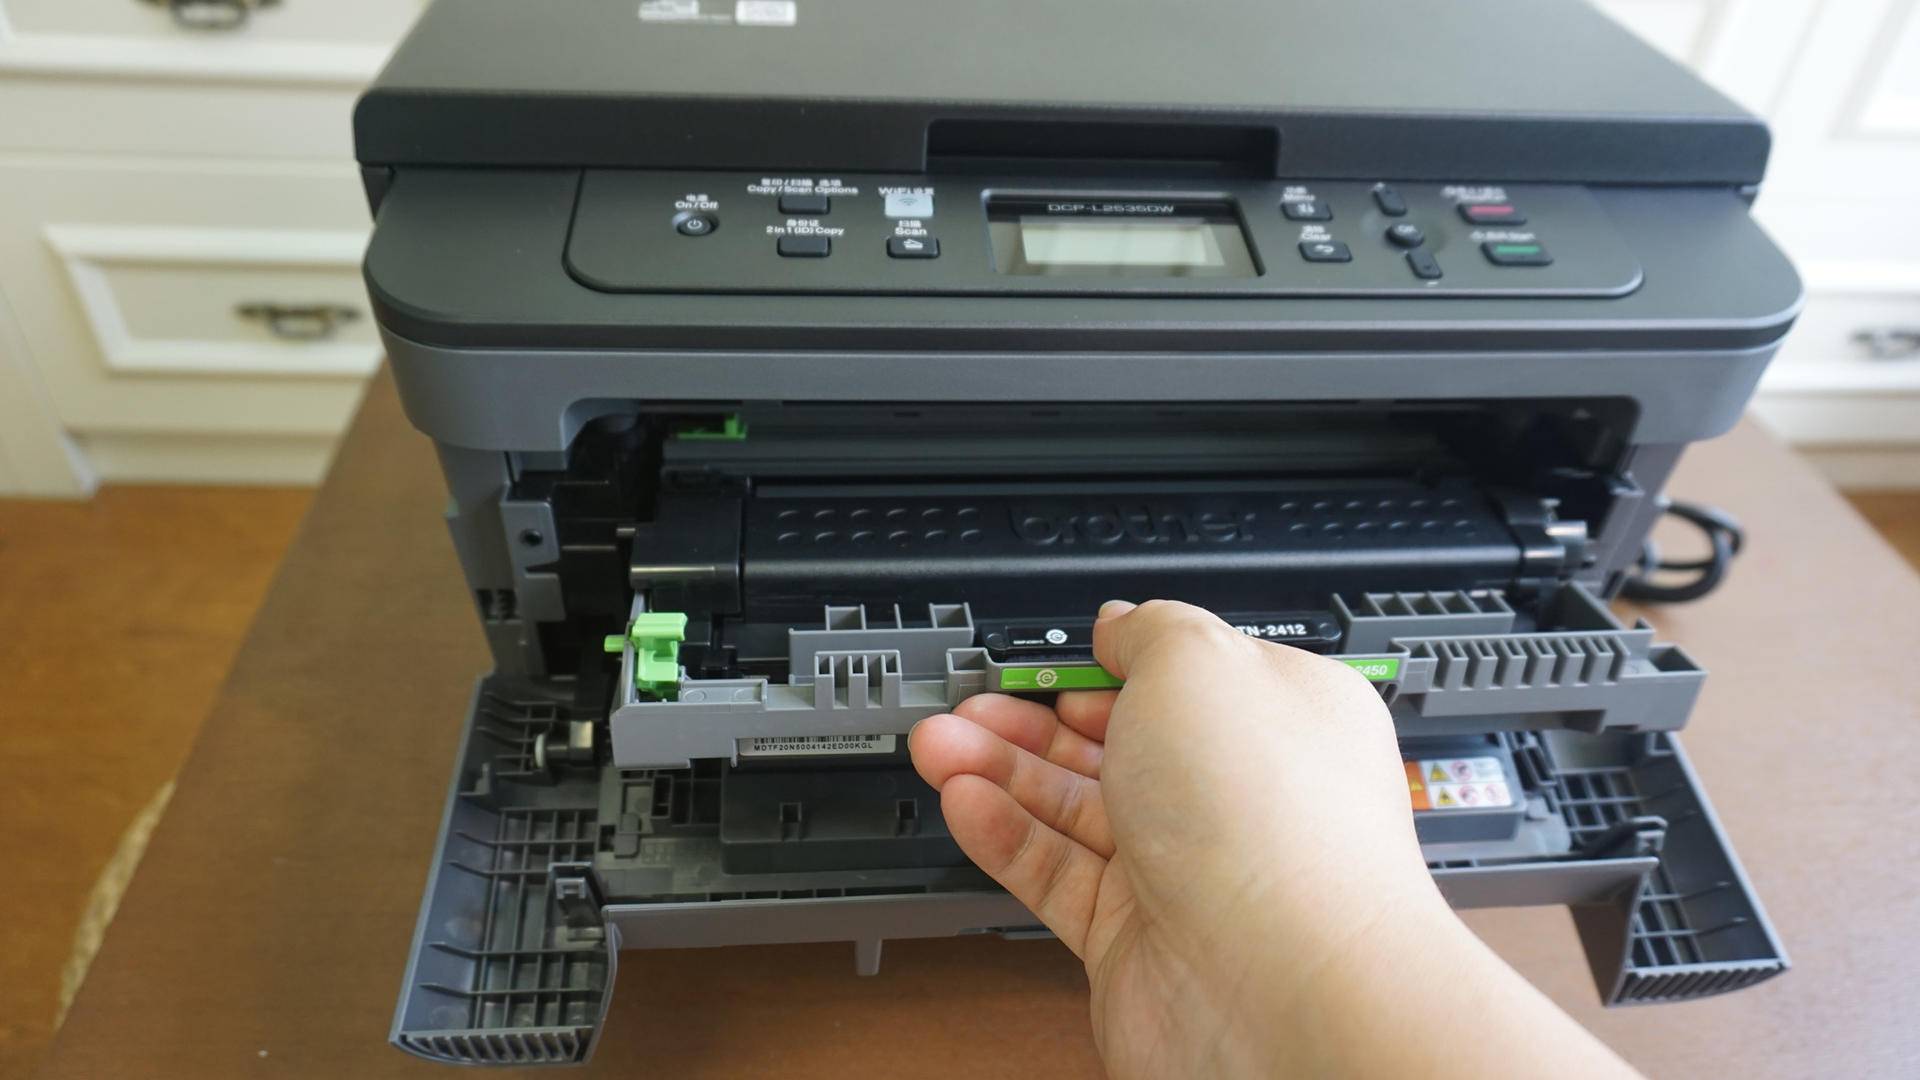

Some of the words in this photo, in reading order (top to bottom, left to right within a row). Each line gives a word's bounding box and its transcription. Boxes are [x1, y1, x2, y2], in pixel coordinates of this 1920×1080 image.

[814, 186, 859, 195] Options
[1048, 203, 1174, 213] DCP-L2535DW
[815, 227, 845, 236] Copy
[895, 227, 927, 236] Scan
[1006, 507, 1257, 546] brother
